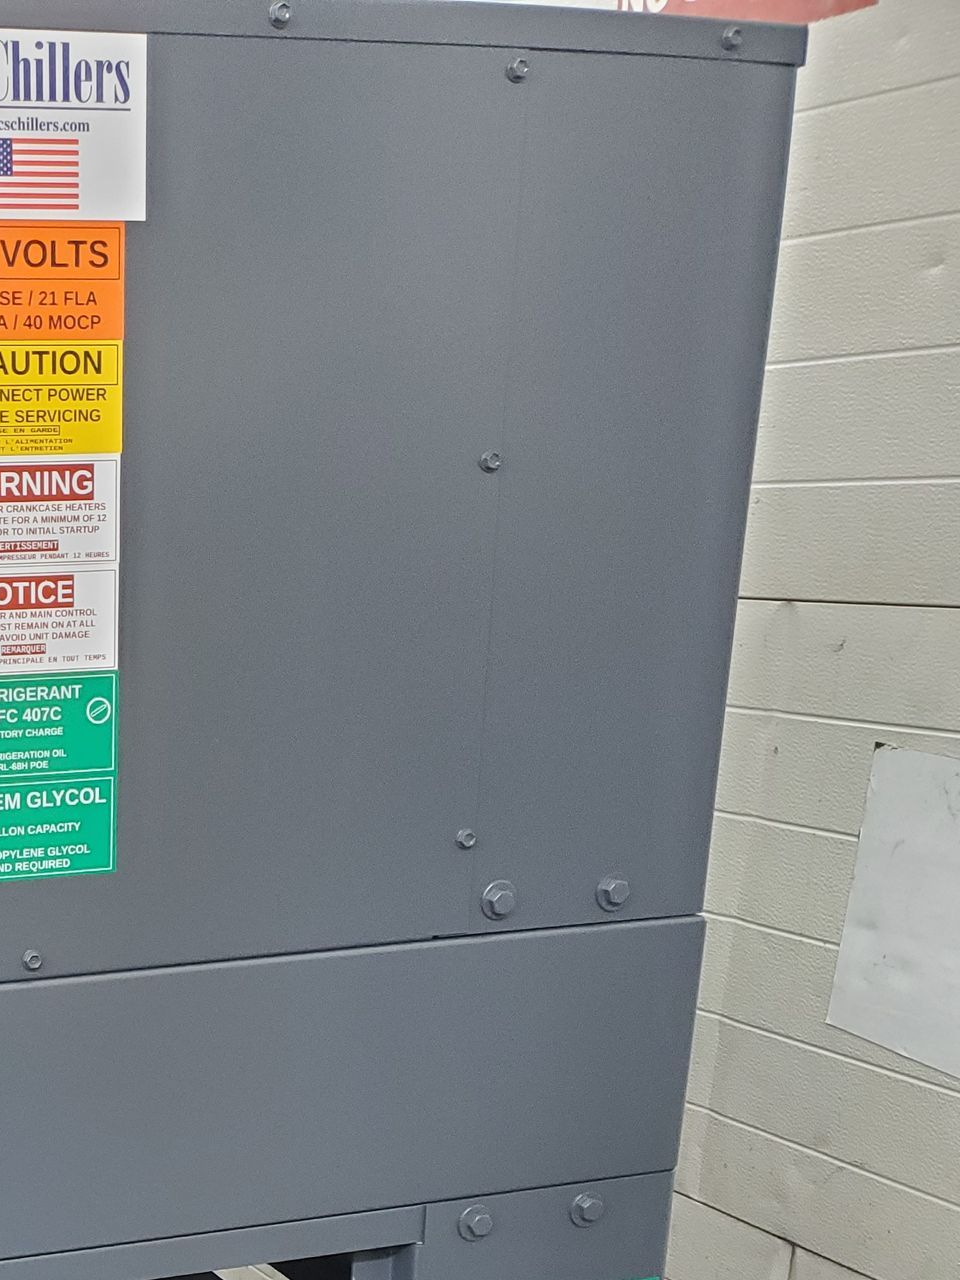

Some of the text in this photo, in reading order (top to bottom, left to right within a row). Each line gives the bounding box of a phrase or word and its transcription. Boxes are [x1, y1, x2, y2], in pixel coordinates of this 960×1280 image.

[0, 239, 109, 268] VOLTS
[38, 291, 58, 306] 21
[64, 291, 97, 306] FLA
[23, 315, 43, 329] 40
[48, 315, 101, 330] MOCP
[48, 388, 107, 401] POWER
[15, 409, 100, 423] SERVICING
[6, 505, 63, 513] CRANKCASE
[65, 503, 106, 511] HEATERS
[11, 516, 30, 524] FOR
[41, 515, 80, 523] MINIMUM
[83, 514, 95, 522] OF
[97, 514, 107, 522] 12
[12, 527, 24, 535] TO
[26, 527, 57, 535] INITIAL
[59, 525, 100, 534] STARTUP
[30, 611, 53, 619] MAIN
[55, 609, 97, 618] CONTROL
[15, 622, 49, 630] REMAIN
[51, 621, 64, 629] ON
[29, 632, 49, 640] UNIT
[51, 631, 90, 639] DAMAGE
[1, 645, 46, 655] REMARQUER
[22, 706, 62, 722] 407C
[26, 727, 63, 737] CHARGE
[52, 749, 67, 758] OIL
[30, 761, 49, 769] POE
[26, 787, 106, 808] GLYCOL
[27, 822, 81, 834] CAPACITY
[47, 844, 90, 856] GLYCOL
[15, 859, 71, 872] REQUIRED
